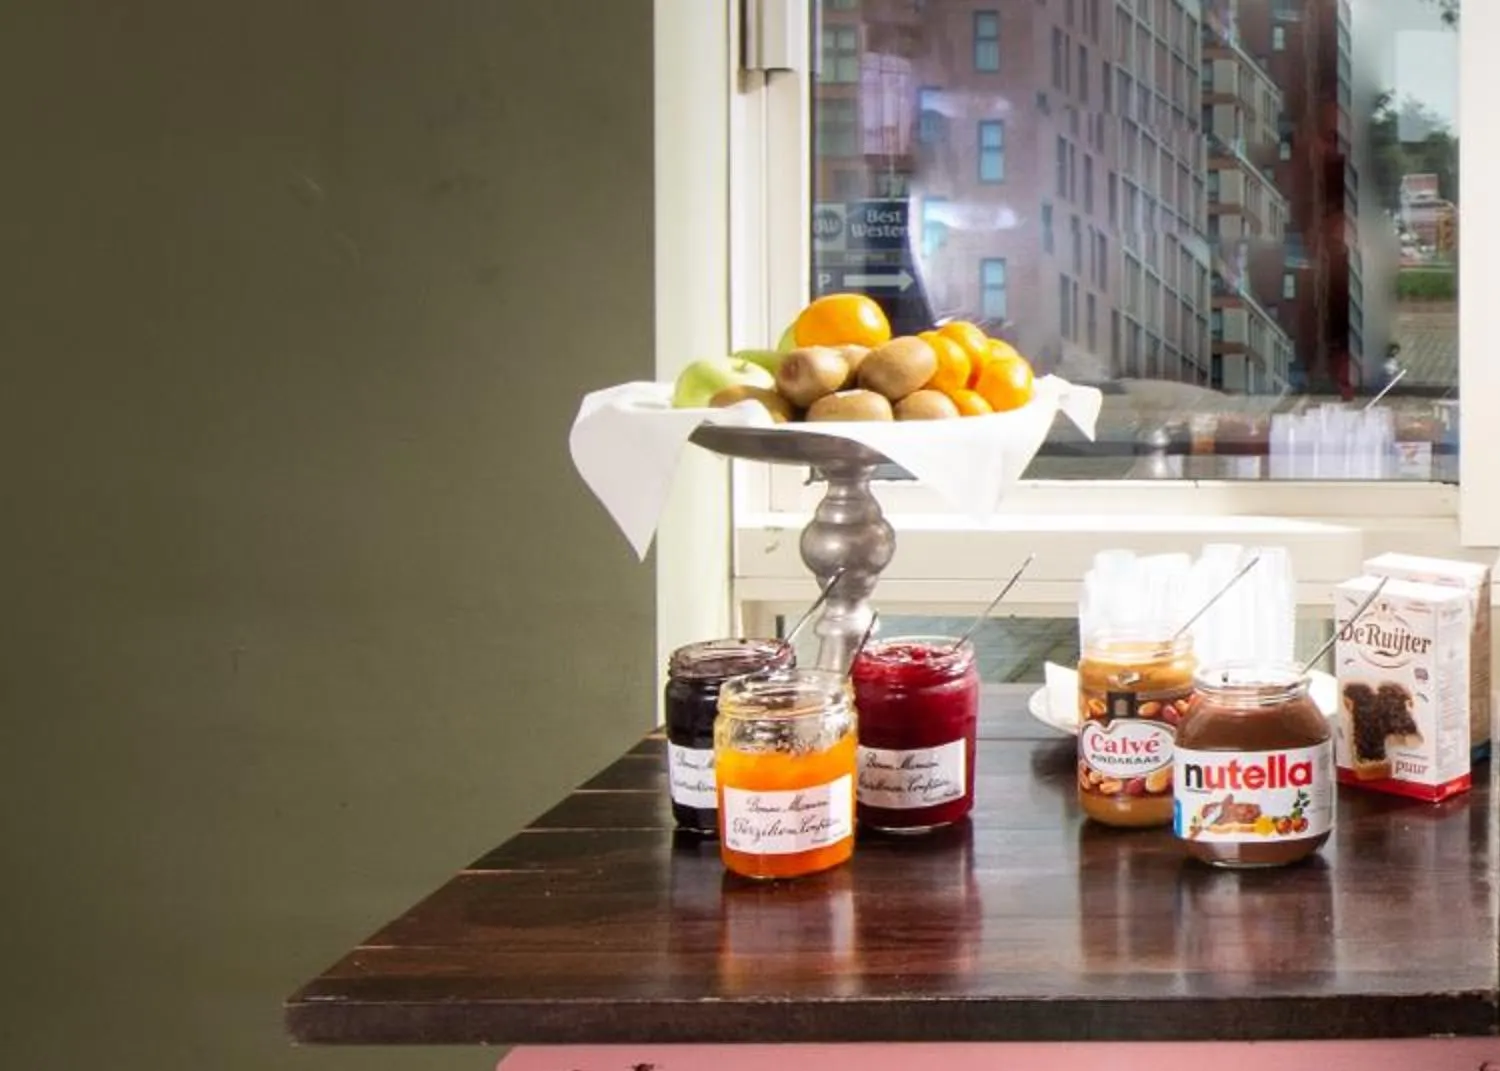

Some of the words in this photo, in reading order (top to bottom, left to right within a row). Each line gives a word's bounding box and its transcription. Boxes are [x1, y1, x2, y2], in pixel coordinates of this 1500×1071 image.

[866, 209, 902, 224] Best
[851, 223, 909, 238] Wester
[1338, 619, 1364, 642] De
[1366, 623, 1432, 657] Ruijter
[1090, 732, 1161, 755] Calvé
[1184, 753, 1313, 790] nutella
[1395, 760, 1429, 775] puur
